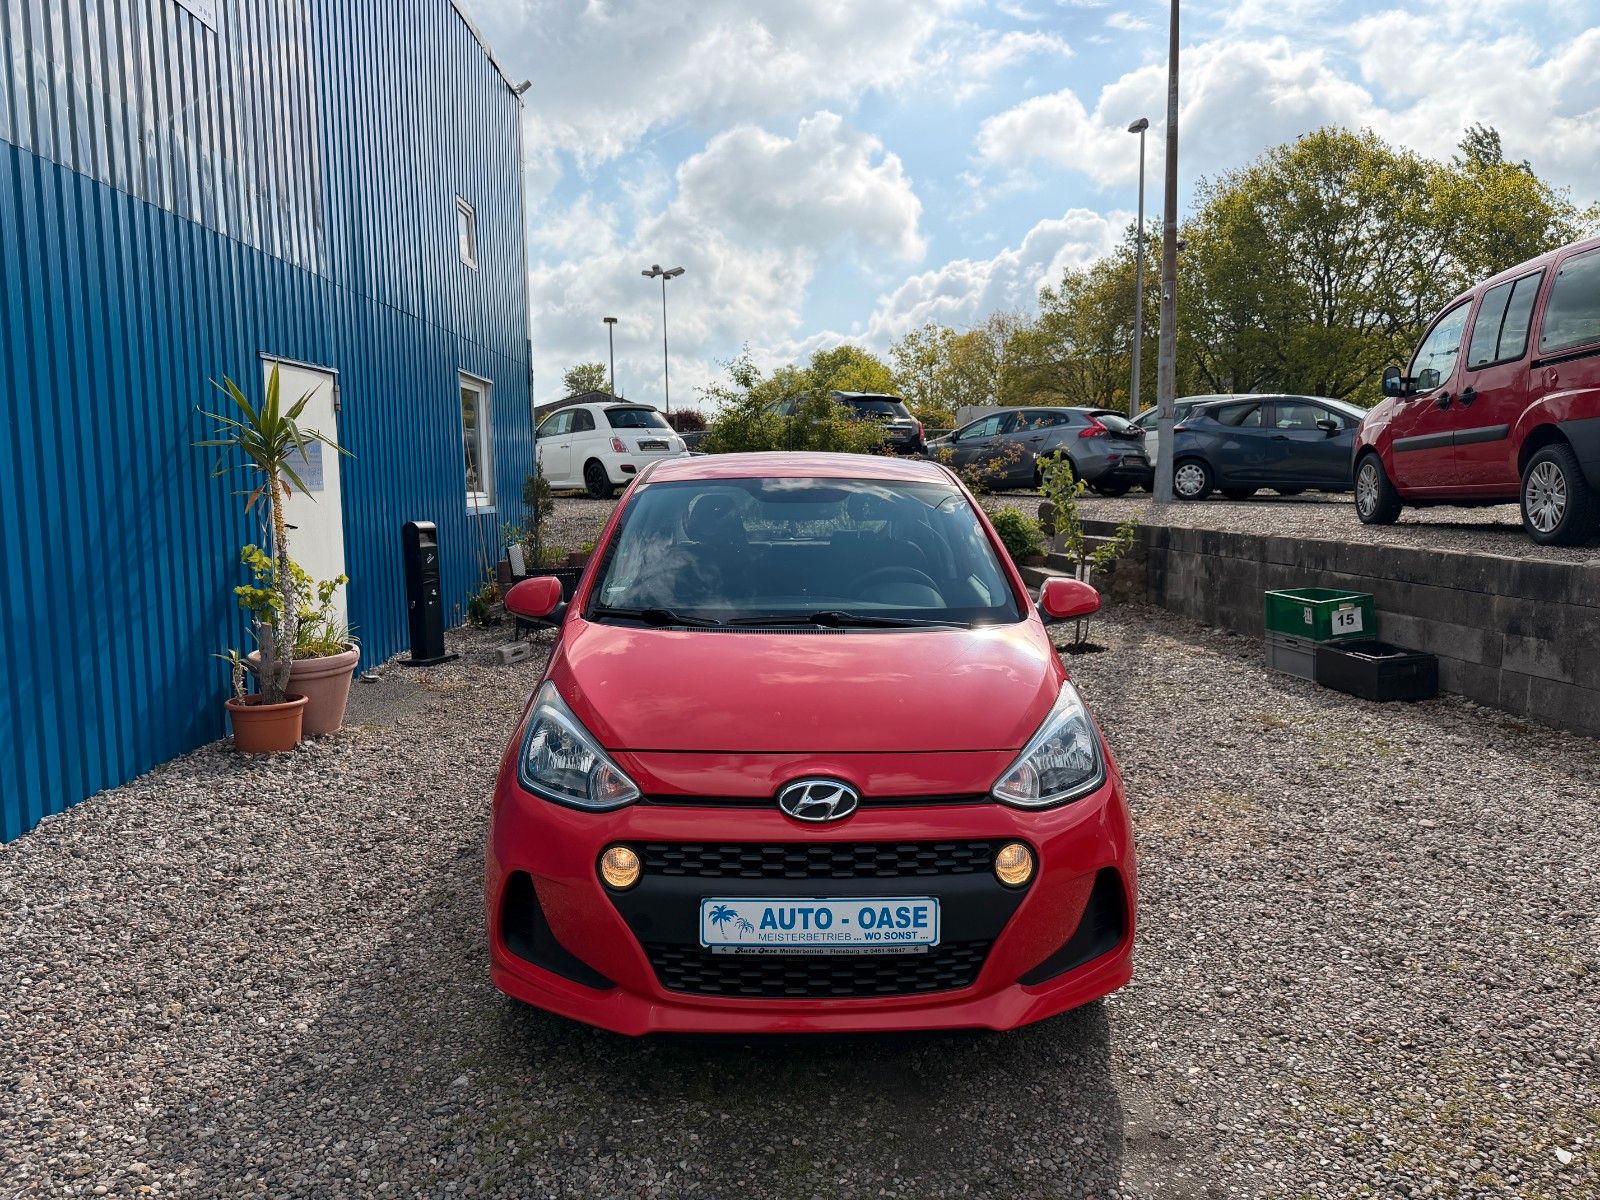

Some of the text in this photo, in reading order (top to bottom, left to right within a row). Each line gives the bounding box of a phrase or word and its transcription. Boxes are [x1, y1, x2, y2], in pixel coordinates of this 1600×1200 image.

[1337, 613, 1355, 627] 15
[760, 907, 833, 930] AUTO
[858, 906, 928, 929] OASE
[758, 932, 851, 942] MEISTERBETRIEB
[864, 932, 881, 941] WO
[884, 931, 918, 940] SONST
